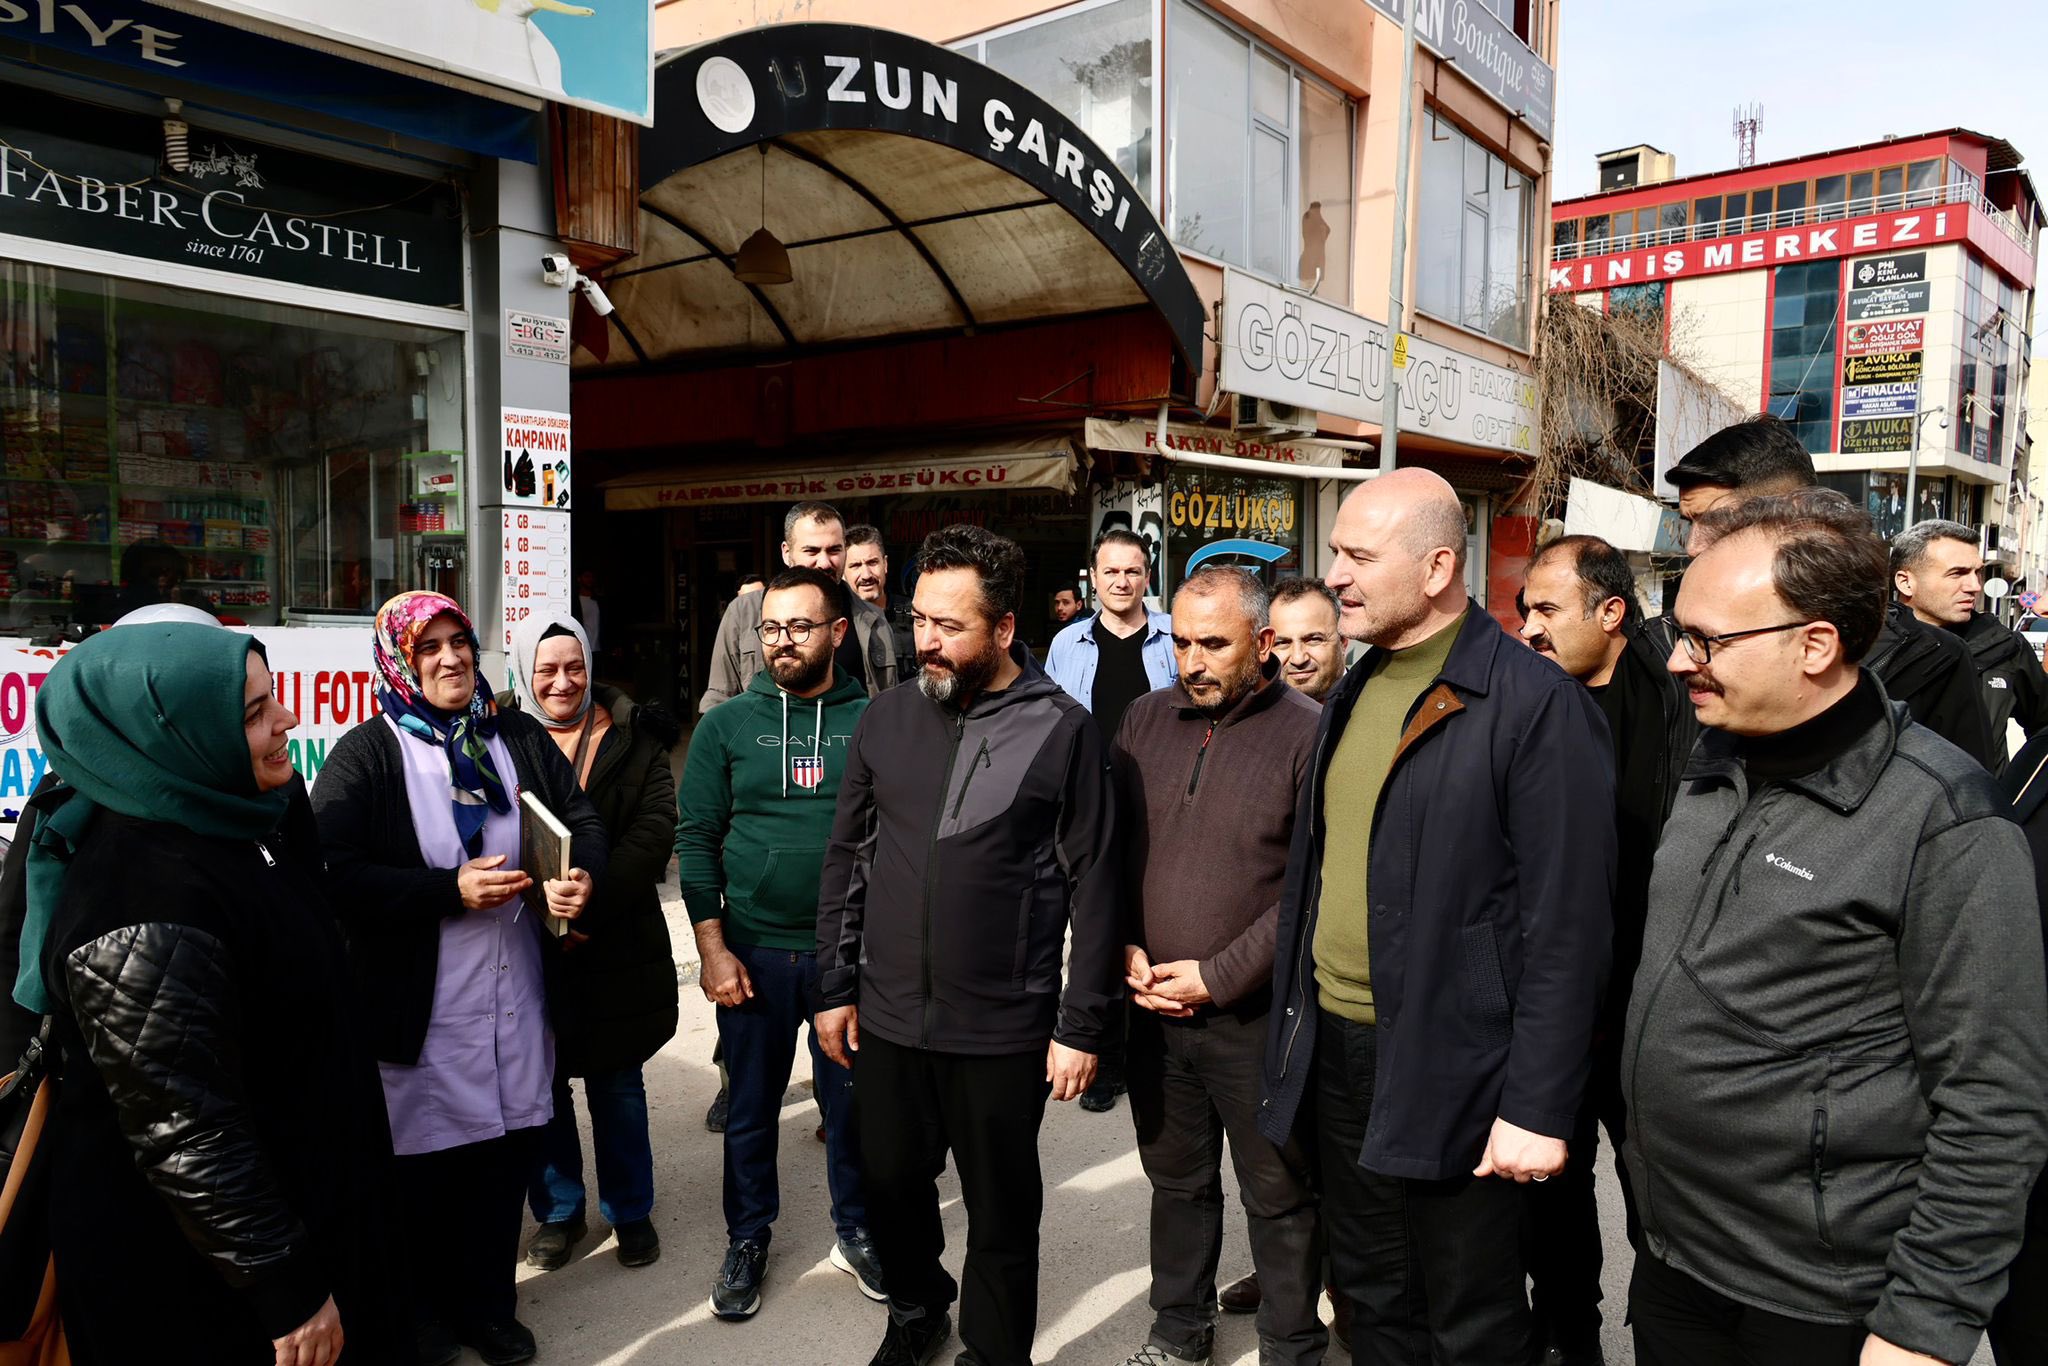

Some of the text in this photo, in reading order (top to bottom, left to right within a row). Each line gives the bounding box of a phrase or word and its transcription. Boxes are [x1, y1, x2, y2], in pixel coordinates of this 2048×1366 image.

[1452, 0, 1523, 97] Boutique
[982, 98, 1131, 233] ÇARŞI
[1703, 212, 1947, 268] MERKEZİ
[185, 238, 265, 265] since 1761
[1877, 268, 1898, 276] KENT
[1878, 260, 1895, 269] PHI
[1877, 272, 1919, 283] PLANLAMA
[523, 324, 554, 341] BGS
[1868, 320, 1922, 335] AVUKAT
[1870, 331, 1917, 342] OĞUZ GÖK
[1238, 300, 1535, 427] GÖZLÜKÇÜ HAKAN
[1865, 351, 1912, 365] AVUKAT
[506, 427, 568, 453] KAMPANYA
[1472, 413, 1530, 451] OPTİK
[1843, 432, 1911, 448] ÜZEYİR KÜÇÜ
[1170, 487, 1295, 538] GÖZLÜKÇÜ
[504, 513, 529, 529] 2 GB
[504, 536, 529, 552] 4 GB
[504, 560, 530, 576] 8 GB
[518, 583, 530, 599] GB
[505, 607, 516, 622] 32
[756, 734, 852, 748] GANT
[1773, 856, 1815, 881] Columbia
